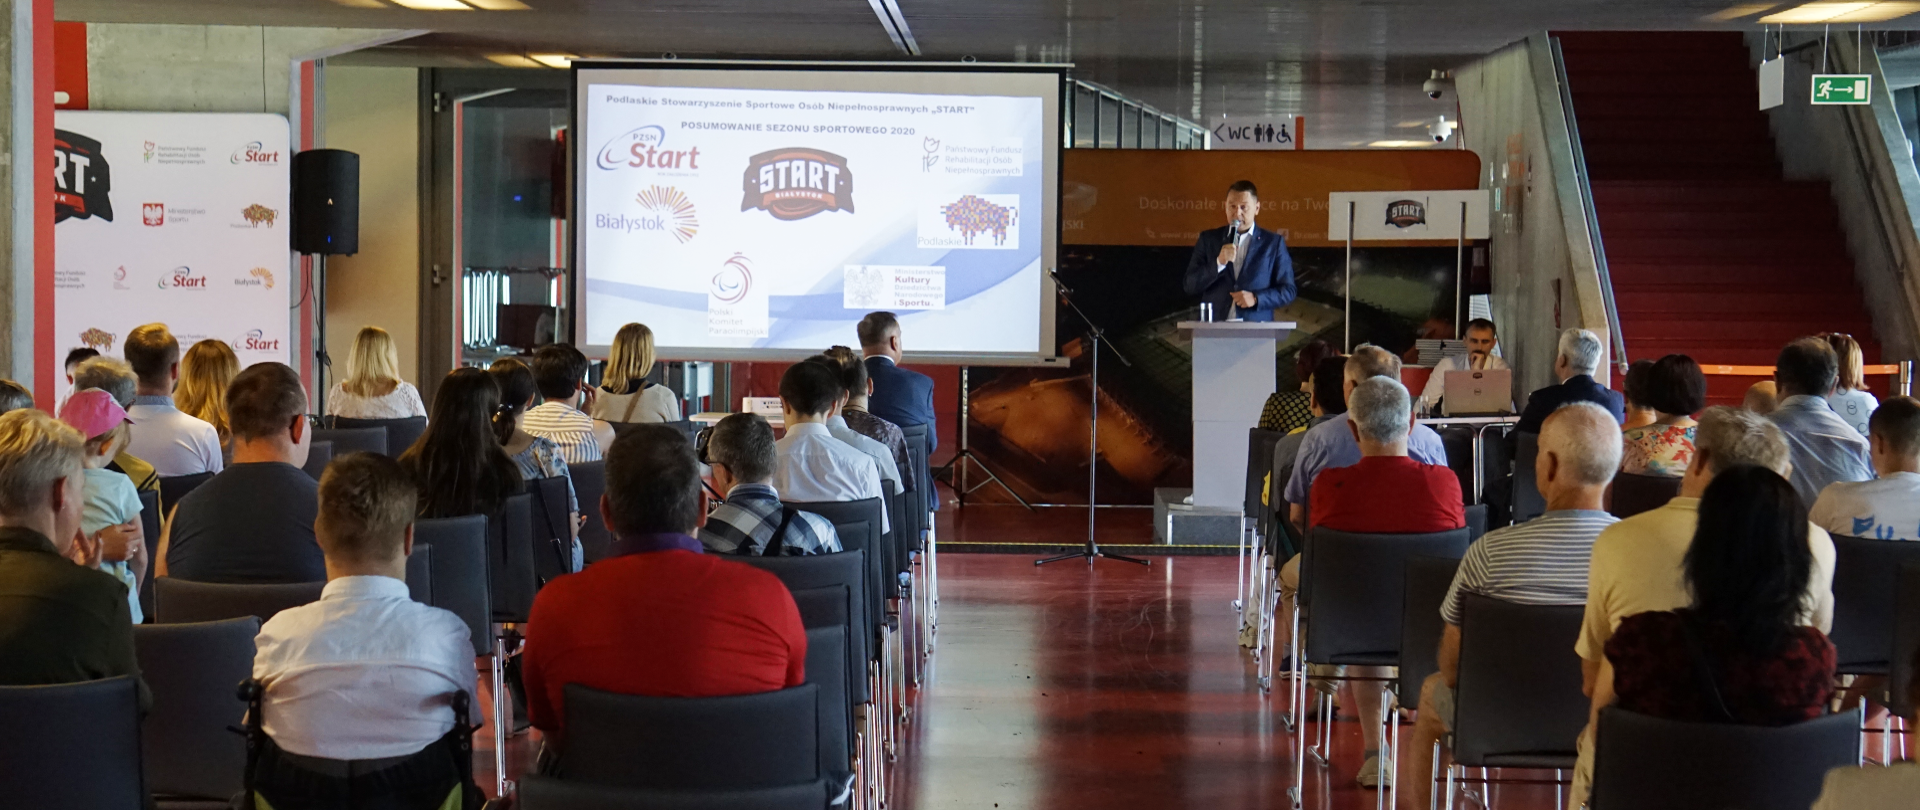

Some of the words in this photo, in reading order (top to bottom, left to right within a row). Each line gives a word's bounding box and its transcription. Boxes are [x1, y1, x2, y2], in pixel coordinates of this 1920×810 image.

[606, 95, 658, 105] Podlaskie
[661, 97, 742, 109] Stowarzyszenie
[745, 100, 795, 110] Sportowe
[798, 101, 824, 111] Osób
[681, 121, 762, 132] POSUMOWANIE
[765, 123, 810, 133] SEZONU
[813, 125, 888, 135] SPORTOWEGO
[890, 127, 916, 136] 2020
[1228, 126, 1251, 140] WC
[632, 133, 657, 142] PZSN
[245, 149, 279, 163] Start
[628, 142, 701, 170] Start
[991, 146, 1023, 154] Fundusz
[759, 159, 840, 194] START
[1391, 204, 1421, 218] START
[595, 213, 665, 234] Białystok
[917, 236, 963, 247] Podlaskie
[172, 274, 207, 288] Start
[894, 276, 932, 286] Kultury
[245, 337, 279, 351] Start
